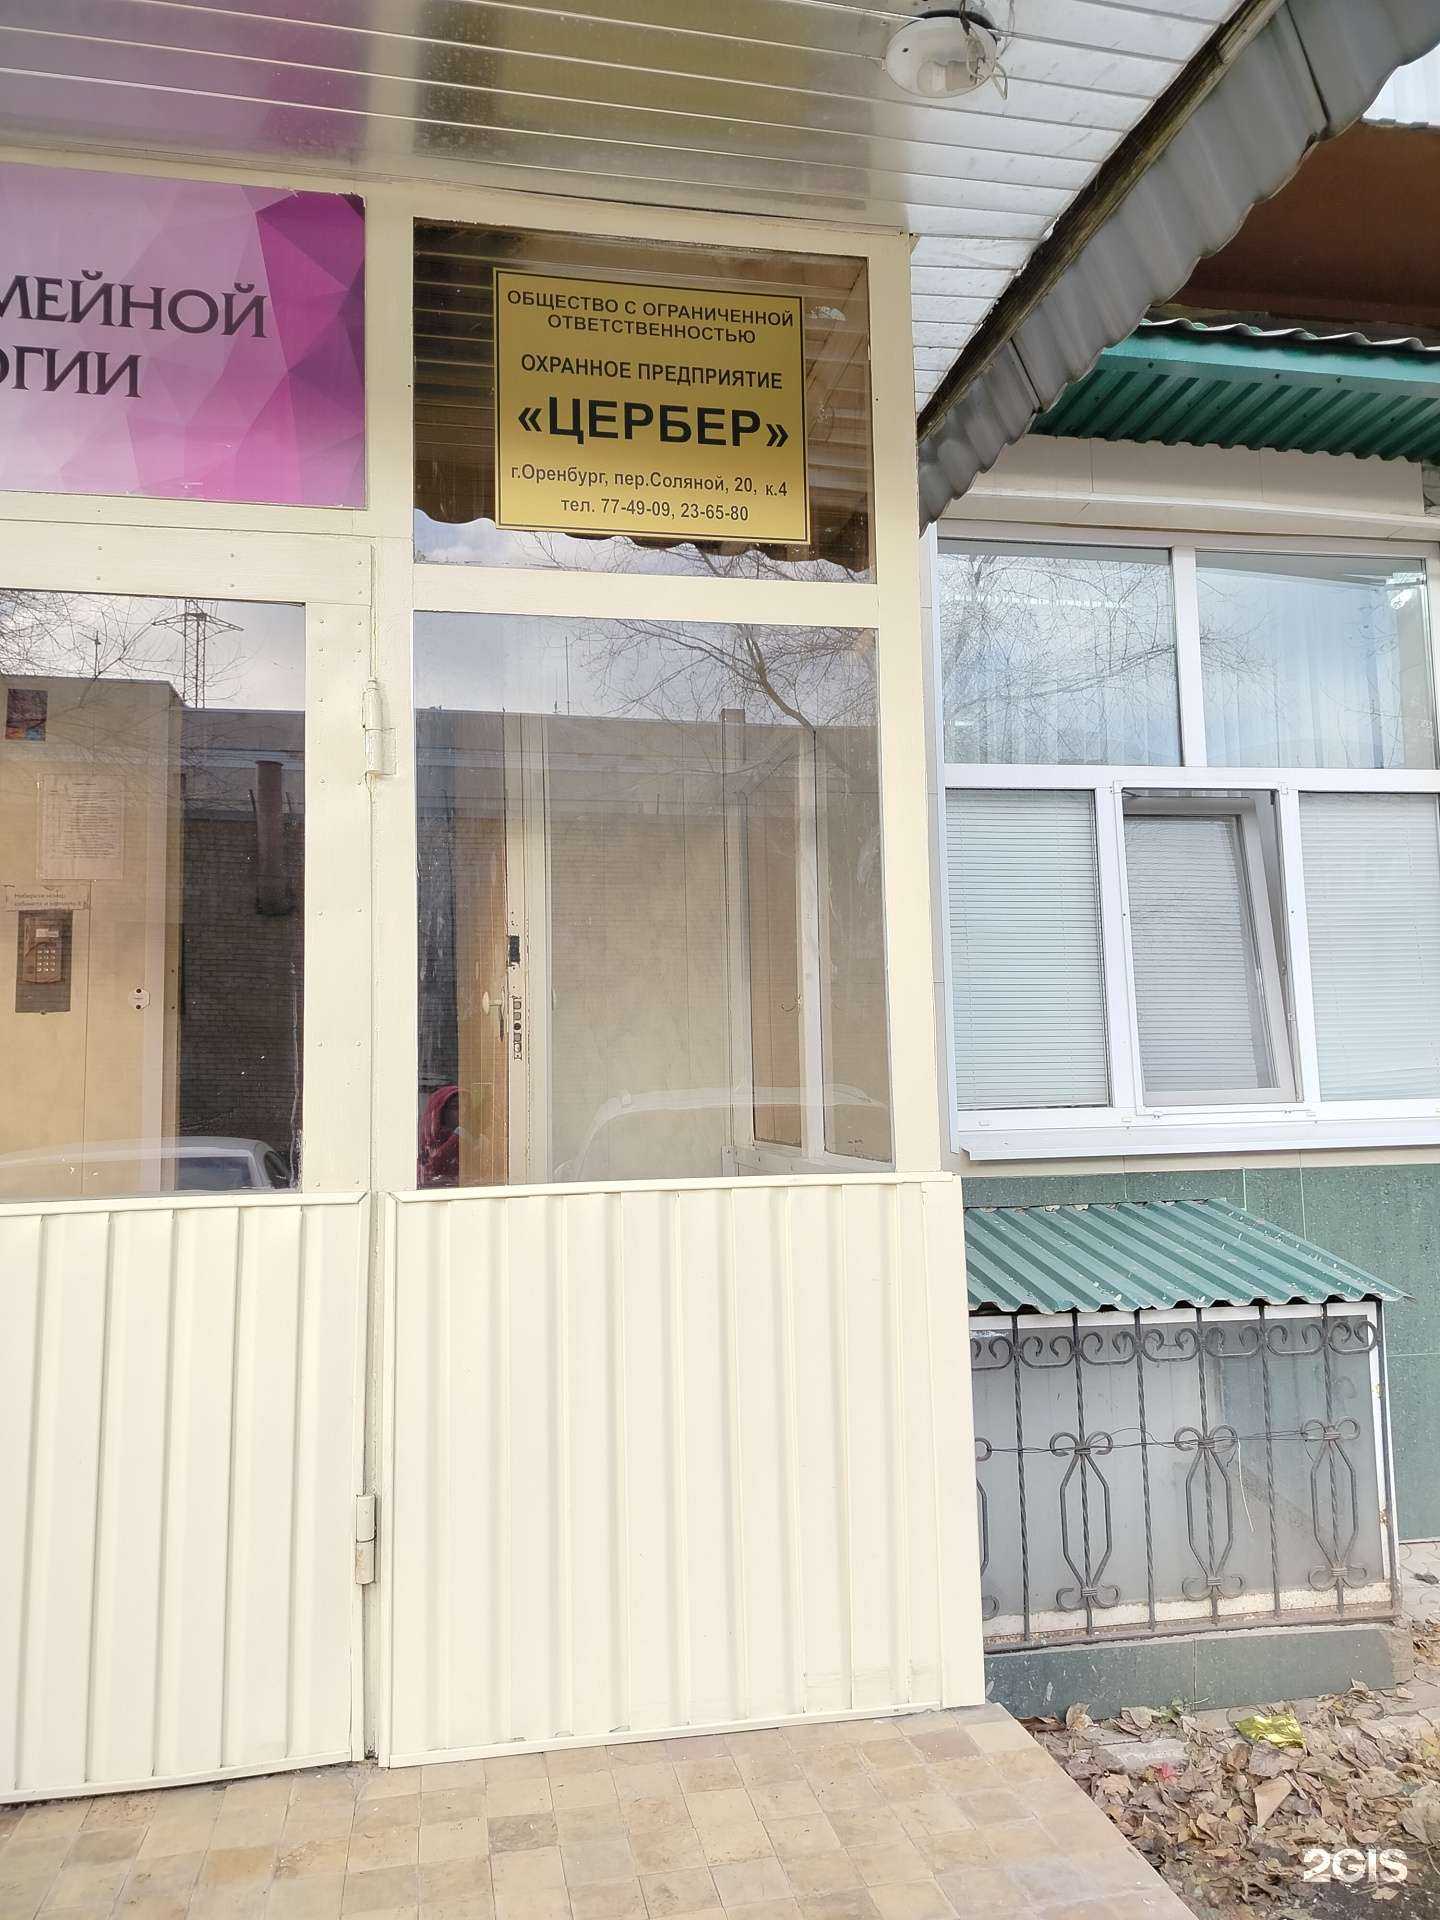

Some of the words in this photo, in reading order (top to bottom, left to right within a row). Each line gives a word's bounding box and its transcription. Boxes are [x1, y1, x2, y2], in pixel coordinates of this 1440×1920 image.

[508, 290, 618, 313] ОБЩЕСТВО
[625, 301, 636, 314] С
[643, 302, 793, 326] ОГРАНИЧЕННОЙ
[548, 315, 755, 343] ОТВЕТСТВЕННОСТЬЮ
[0, 345, 142, 398] ГИИ
[521, 354, 631, 379] ОХРАННОЕ
[638, 363, 782, 389] ПРЕДПРИЯТИЕ
[518, 396, 789, 447] «ЦЕРБЕР»
[511, 465, 609, 486] г.Оренбург,
[614, 472, 728, 493] пер.Соляной,
[734, 477, 757, 494] 20,
[765, 481, 787, 496] к.4
[561, 498, 594, 513] тел.
[601, 499, 674, 519] 77-49-09,
[681, 503, 748, 521] 23-65-80
